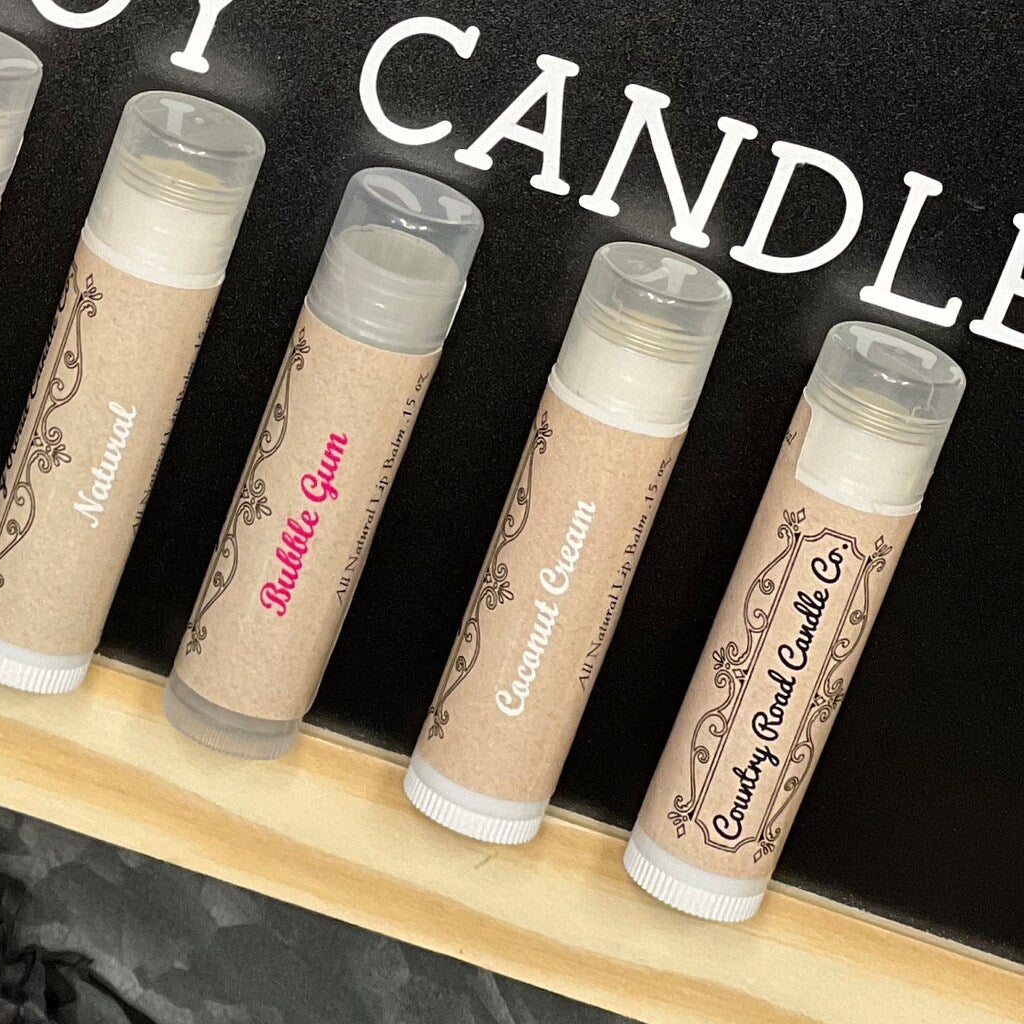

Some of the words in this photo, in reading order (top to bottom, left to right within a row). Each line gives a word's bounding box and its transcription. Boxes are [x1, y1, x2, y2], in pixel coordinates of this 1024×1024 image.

[73, 400, 137, 528] Natural
[260, 510, 319, 617] Bubble
[300, 432, 349, 503] Gum
[336, 575, 351, 604] All
[345, 509, 376, 571] Natural
[369, 476, 389, 506] Lip
[382, 428, 406, 470] Balm
[495, 599, 559, 717] Coconut
[539, 499, 597, 596] Cream
[578, 663, 594, 691] All
[586, 595, 619, 660] Natural
[612, 562, 632, 591] Lip
[624, 511, 648, 556] Balm
[712, 745, 779, 841] Country
[752, 669, 796, 742] Road
[778, 588, 829, 671] Candle
[811, 543, 849, 584] Co.
